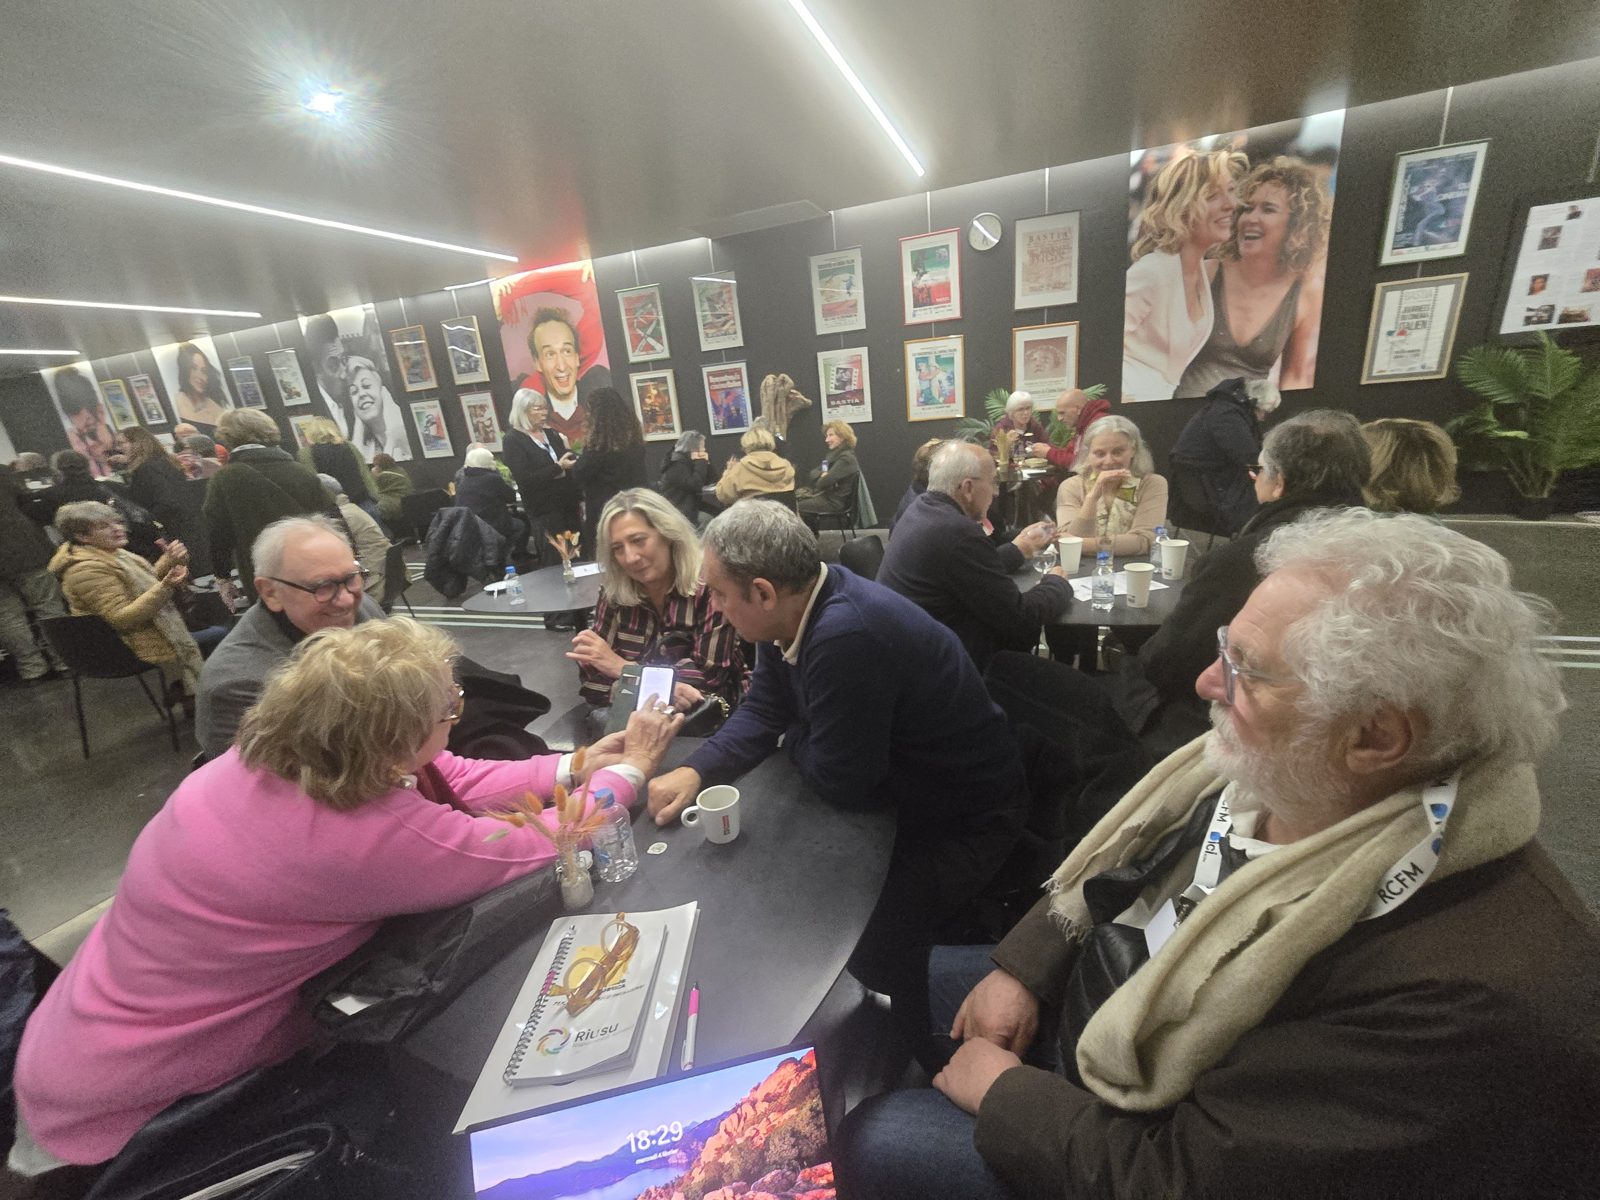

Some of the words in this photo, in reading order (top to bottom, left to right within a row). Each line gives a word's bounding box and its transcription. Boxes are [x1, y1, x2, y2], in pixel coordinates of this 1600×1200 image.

[830, 398, 860, 406] BASTIA
[1377, 862, 1424, 904] RCFM
[574, 1023, 619, 1042] Riusu
[626, 1121, 683, 1153] 18:29
